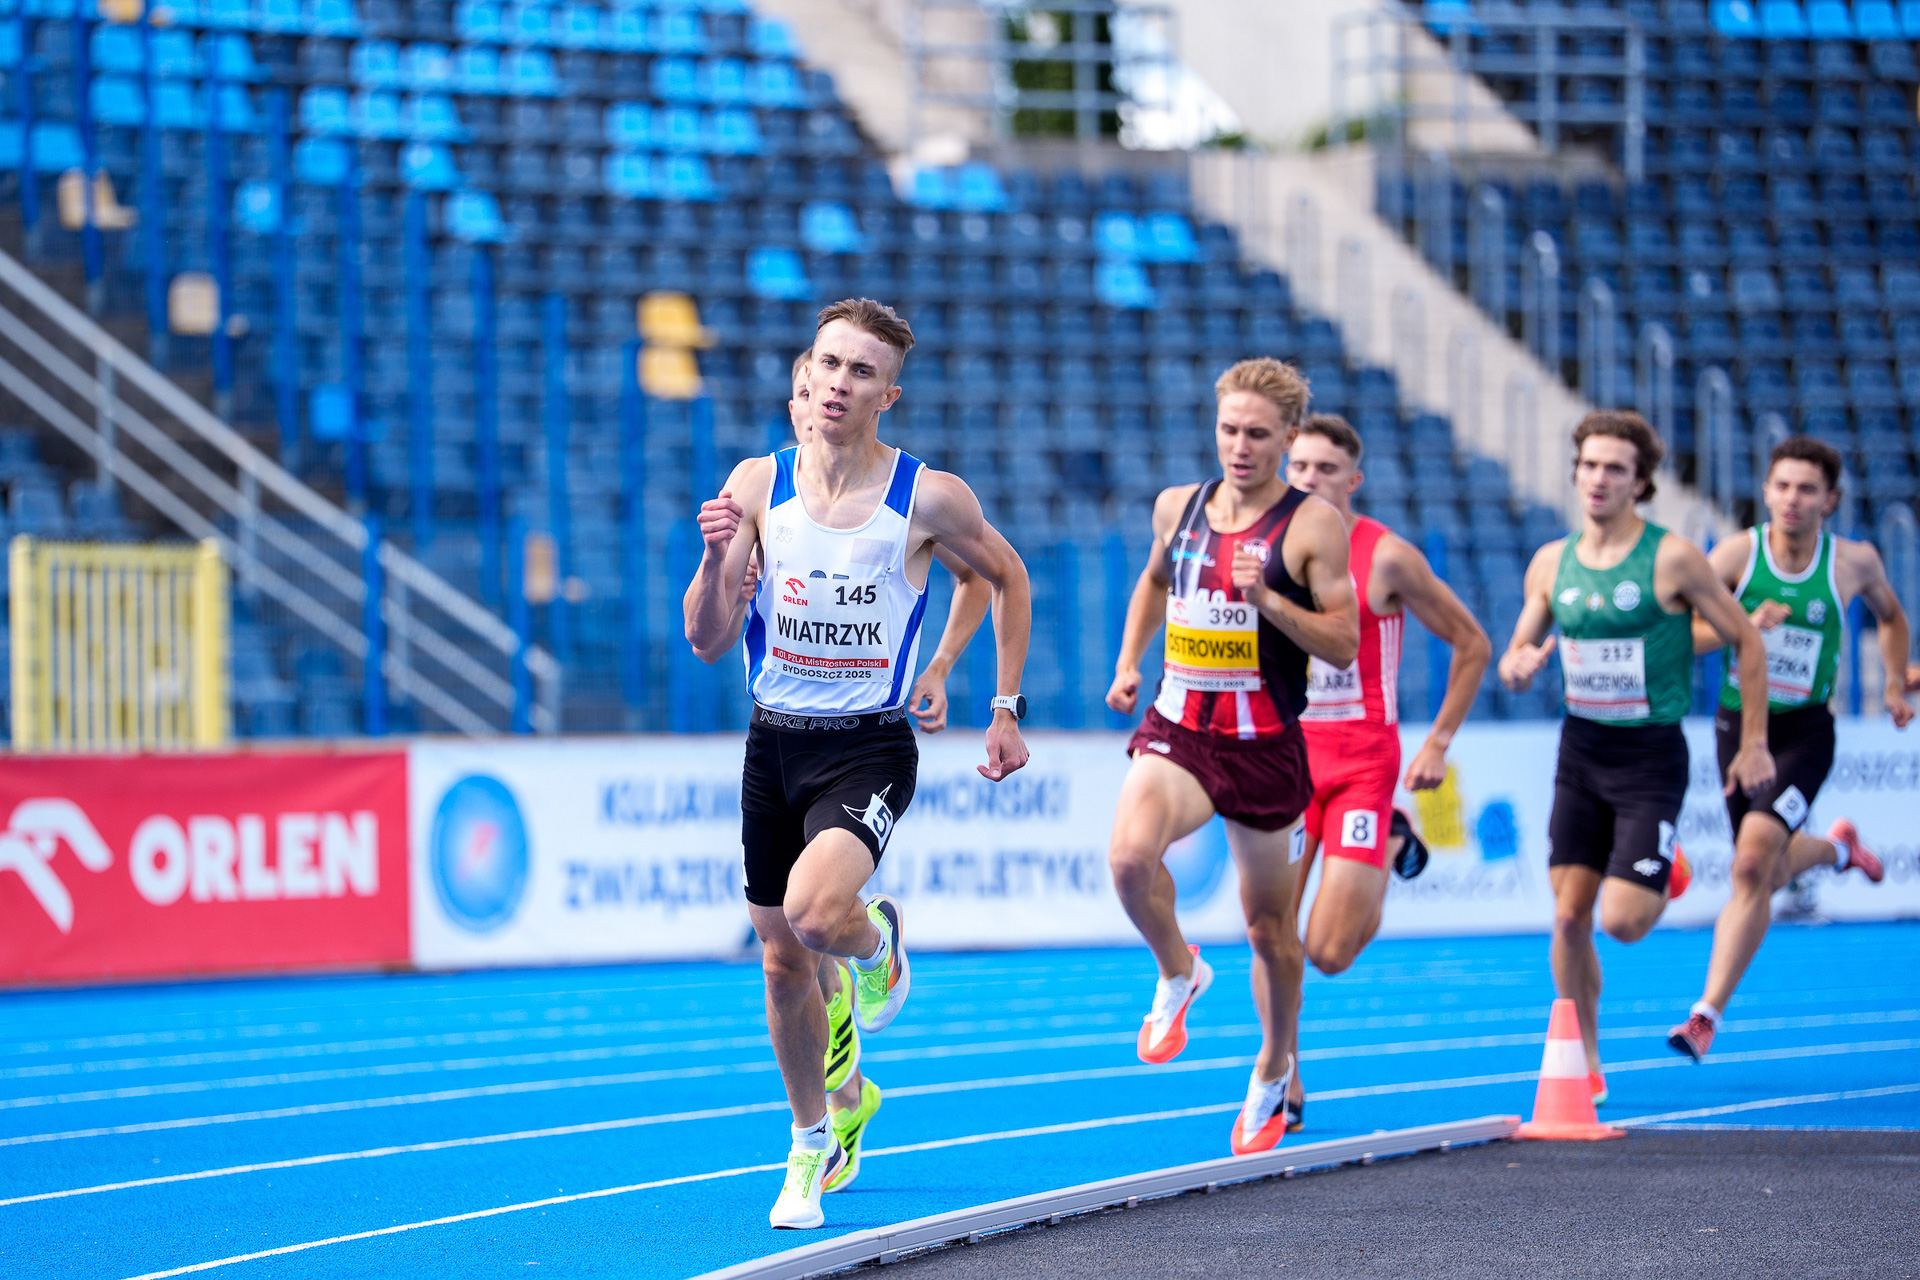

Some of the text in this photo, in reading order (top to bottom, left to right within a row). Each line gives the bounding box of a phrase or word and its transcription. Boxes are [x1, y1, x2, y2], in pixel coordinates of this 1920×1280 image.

[783, 594, 808, 606] ORLEN
[835, 585, 877, 606] 145
[1209, 608, 1247, 626] 390
[777, 612, 883, 646] WIATRZYK
[782, 663, 872, 679] BYDGOSZCZ 2025
[788, 654, 805, 665] PZLA
[805, 658, 855, 668] Mistrzostwa
[760, 710, 860, 731] NIKE PRO
[872, 804, 892, 838] 5
[1352, 815, 1368, 841] 8
[128, 810, 380, 906] ORLEN
